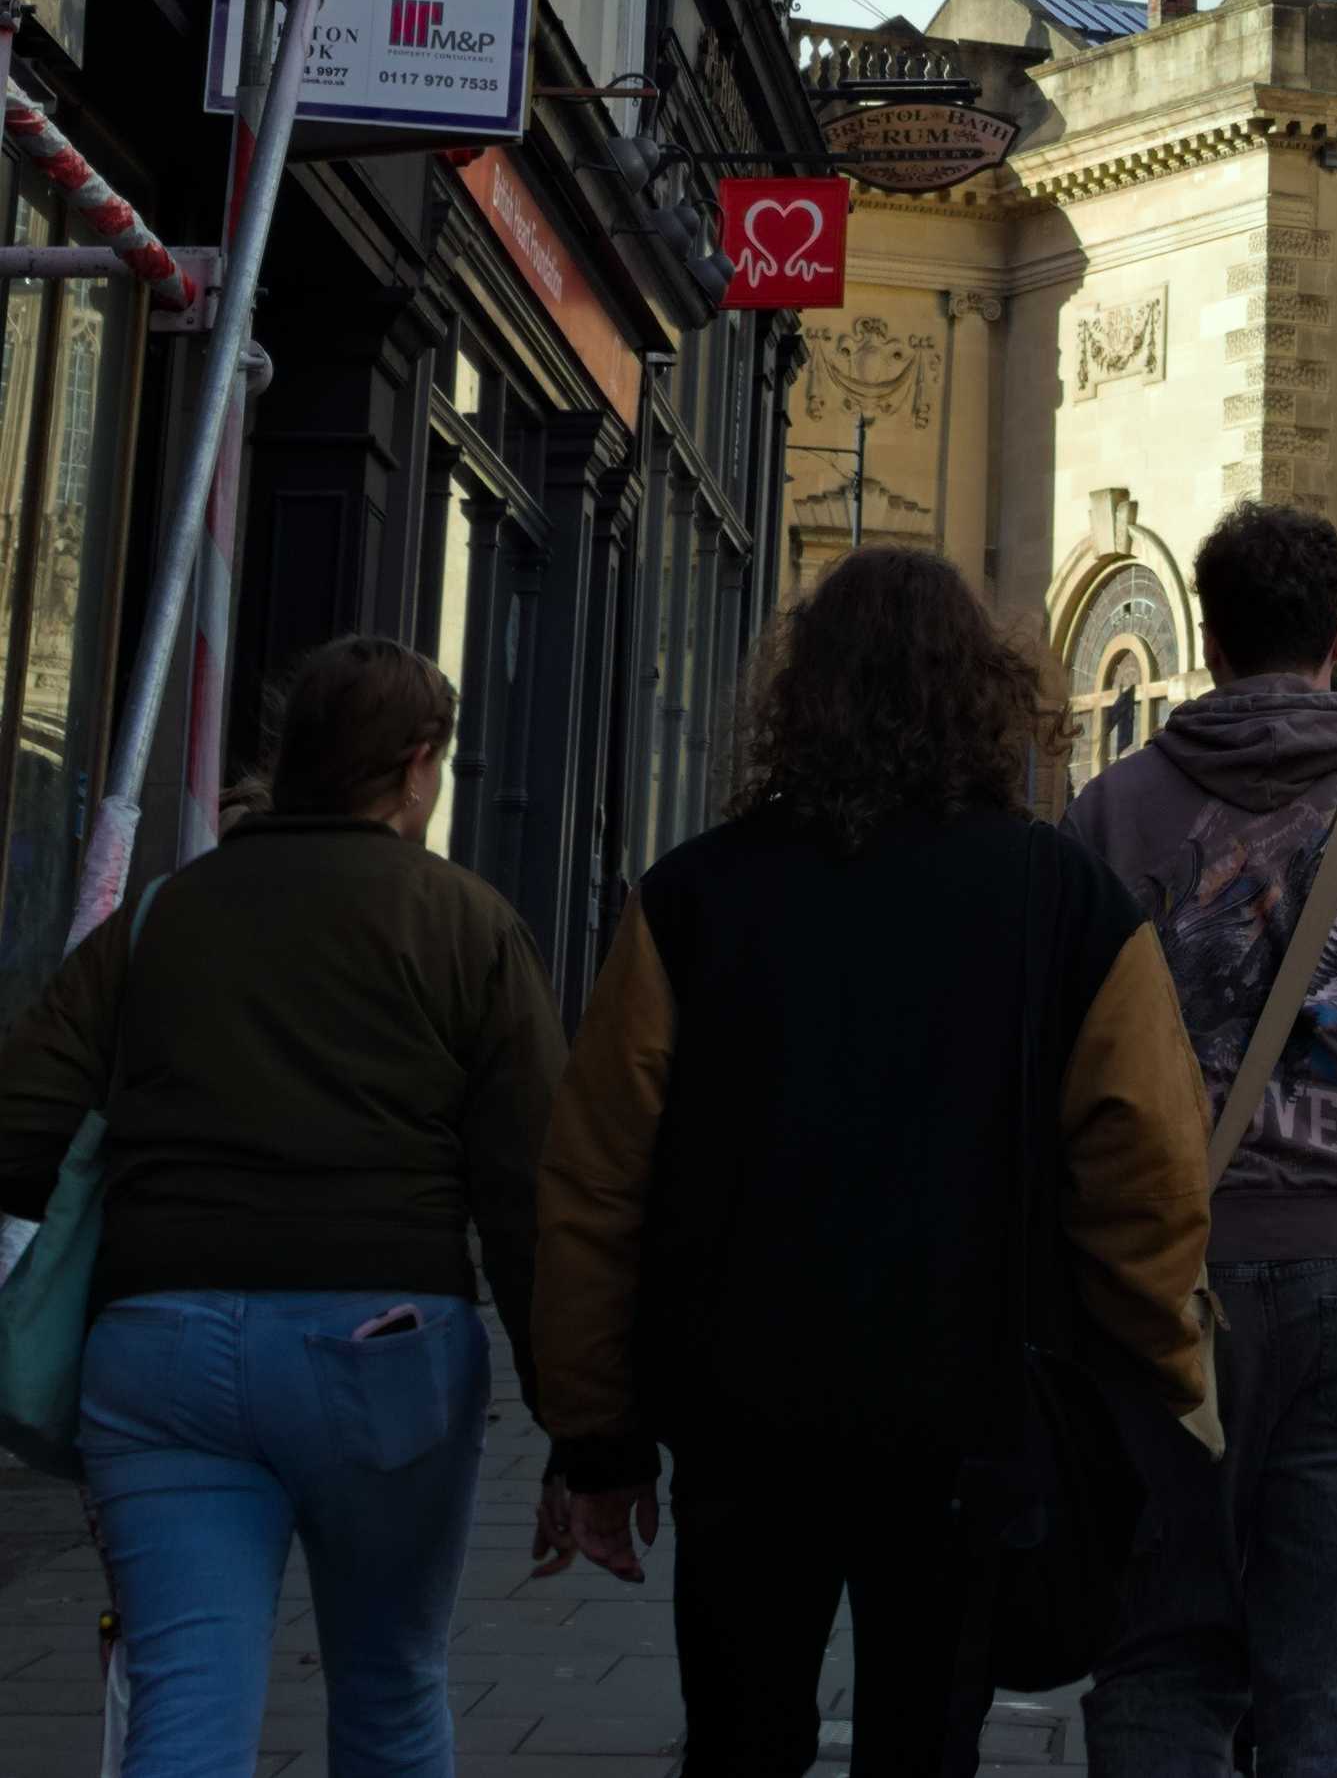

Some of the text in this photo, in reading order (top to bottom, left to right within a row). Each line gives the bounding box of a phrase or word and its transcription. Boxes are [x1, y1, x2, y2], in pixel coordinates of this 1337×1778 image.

[431, 30, 495, 53] M&P
[379, 71, 498, 91] 0117 970 7535
[824, 109, 927, 143] BRISTOL
[948, 109, 1008, 142] BATH
[883, 129, 949, 144] RUM
